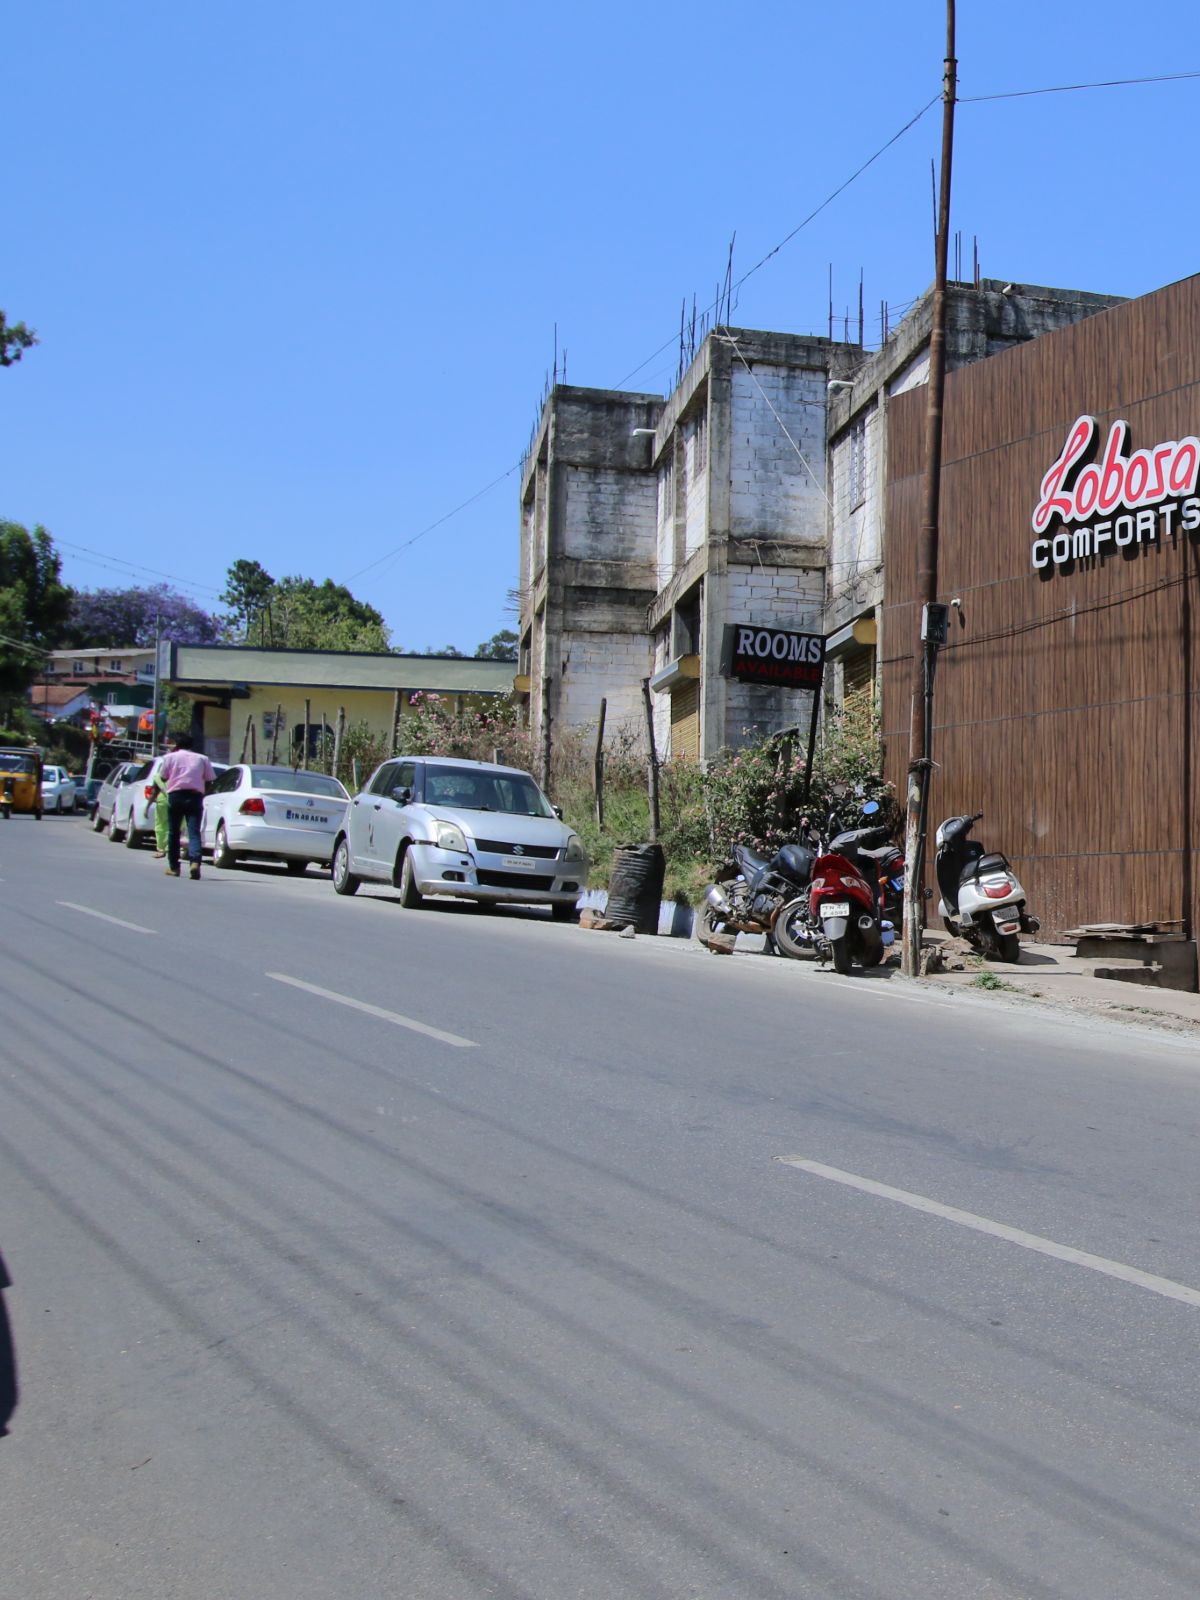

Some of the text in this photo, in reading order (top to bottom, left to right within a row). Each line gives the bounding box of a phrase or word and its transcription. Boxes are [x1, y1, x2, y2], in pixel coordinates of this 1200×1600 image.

[1033, 416, 1200, 532] Lobosa
[1032, 497, 1200, 568] COMFORTS
[735, 661, 819, 680] AVAILABLE
[737, 629, 821, 663] ROOMS
